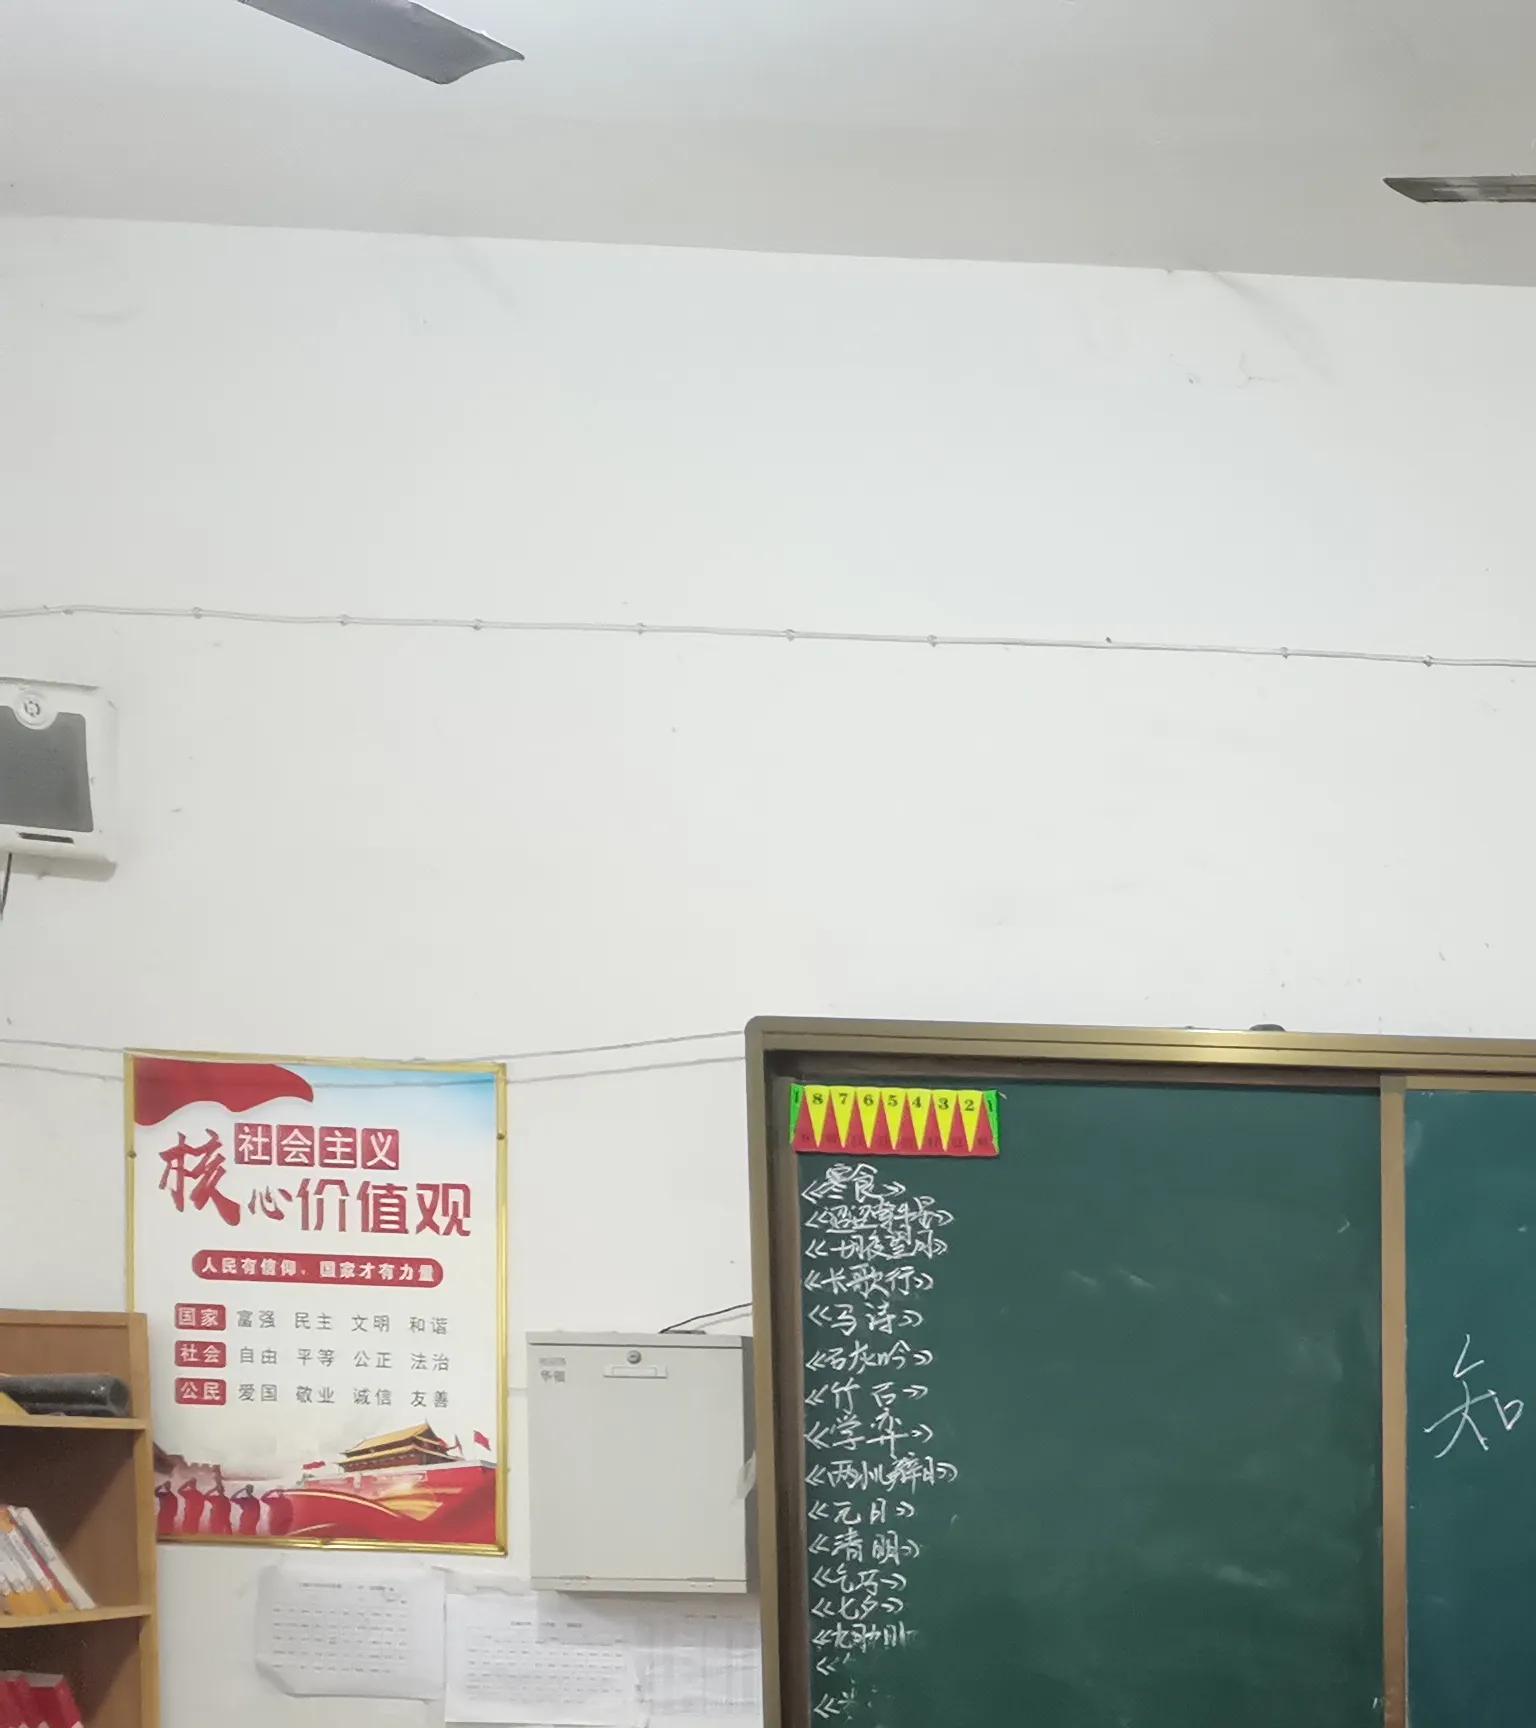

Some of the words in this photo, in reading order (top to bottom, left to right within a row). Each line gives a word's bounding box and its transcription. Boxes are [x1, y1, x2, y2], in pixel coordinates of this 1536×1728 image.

[812, 1092, 824, 1105] 8
[838, 1093, 850, 1106] 7
[863, 1094, 874, 1106] 6
[887, 1095, 899, 1107] 5
[911, 1096, 923, 1109] 4
[938, 1097, 950, 1111] 3
[964, 1099, 975, 1112] 2
[237, 1125, 398, 1168] 社会主义
[178, 1307, 220, 1328] 国家
[237, 1310, 277, 1329] 富强
[295, 1312, 334, 1331] 民主
[352, 1315, 390, 1333] 文明
[410, 1317, 449, 1335] 和谐
[179, 1344, 222, 1364] 社会
[239, 1347, 279, 1365] 自由
[297, 1348, 336, 1368] 平等
[353, 1350, 393, 1369] 公正
[411, 1353, 450, 1372] 法治
[180, 1382, 222, 1401] 公民
[239, 1384, 279, 1402] 爱国
[296, 1386, 336, 1404] 敬业
[353, 1389, 393, 1407] 诚信
[411, 1391, 450, 1409] 友善
